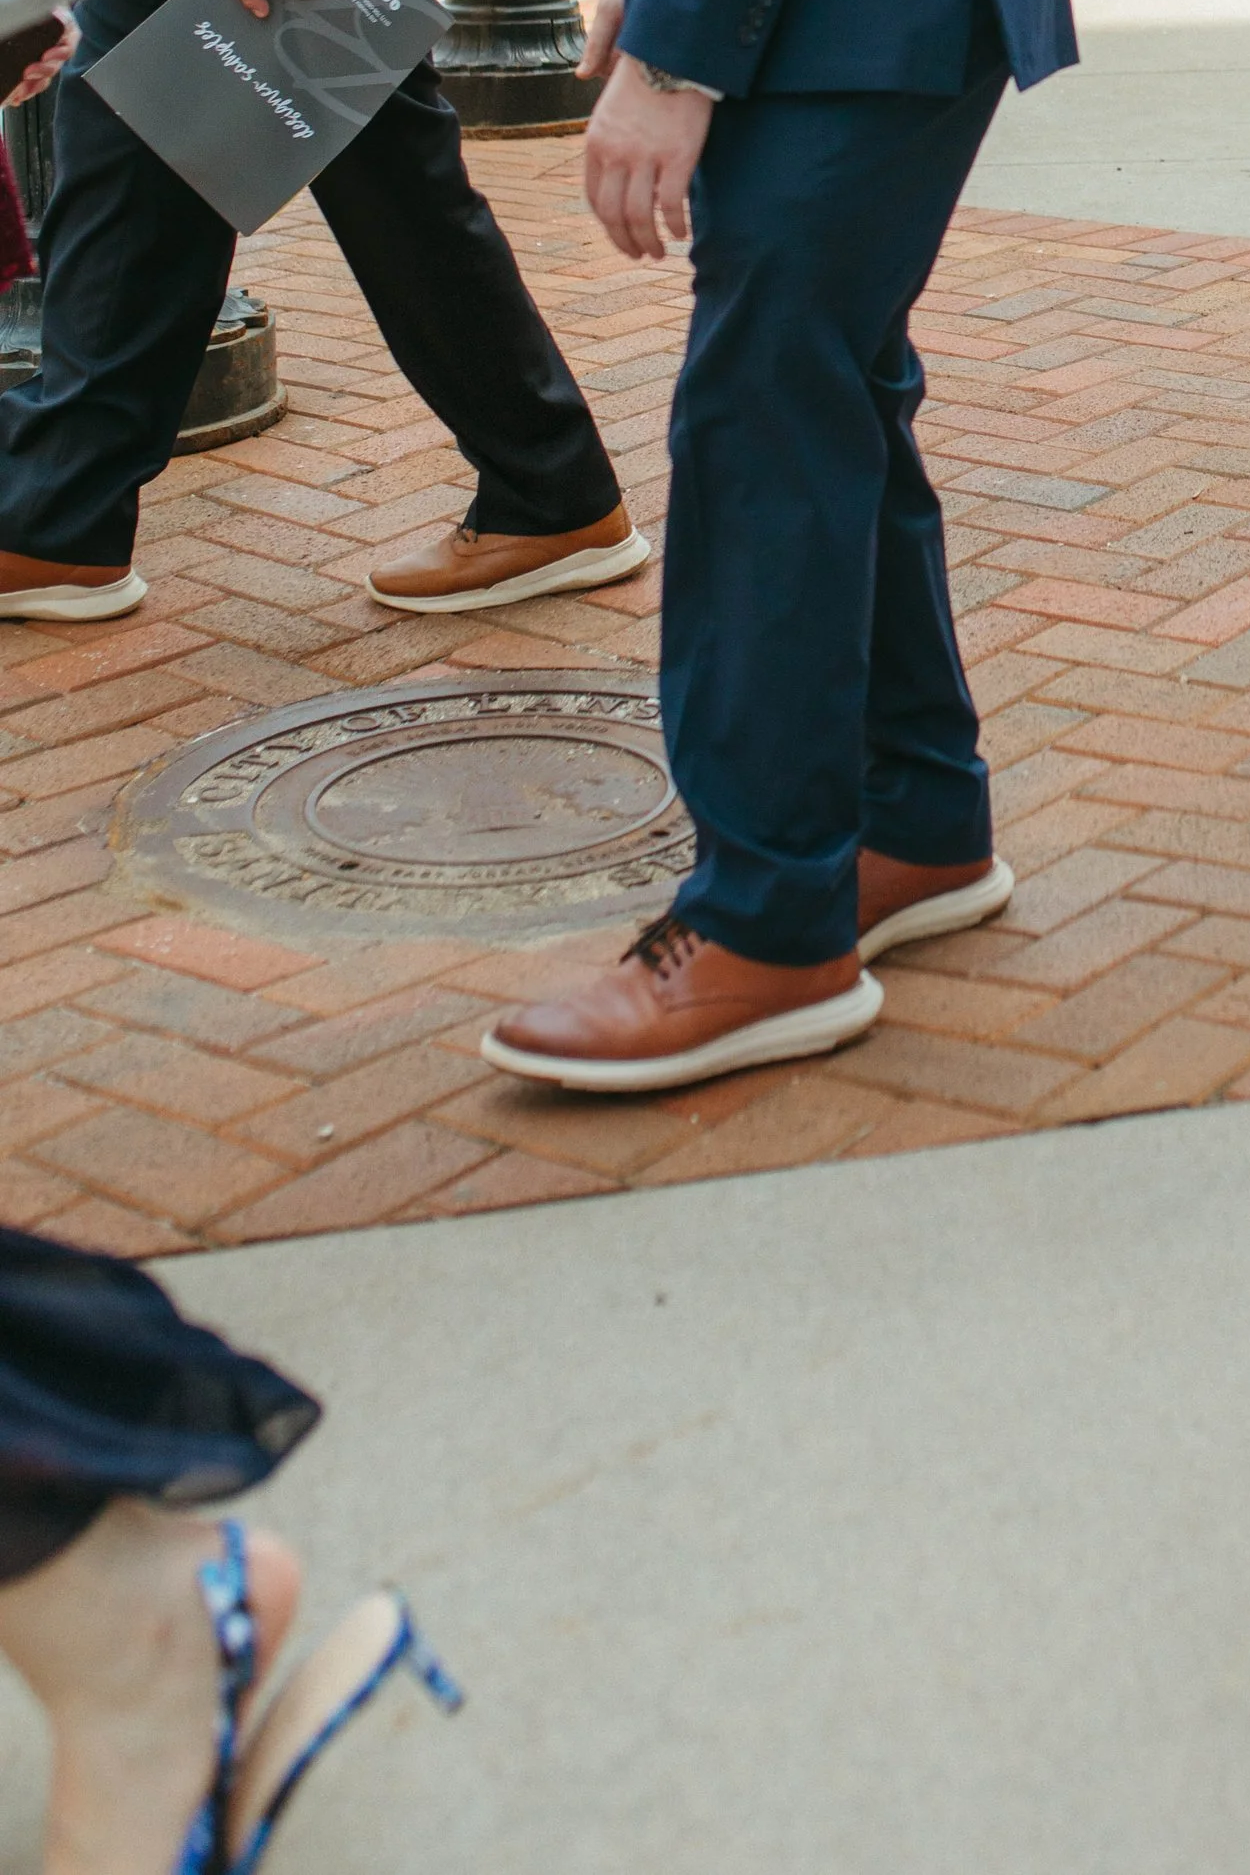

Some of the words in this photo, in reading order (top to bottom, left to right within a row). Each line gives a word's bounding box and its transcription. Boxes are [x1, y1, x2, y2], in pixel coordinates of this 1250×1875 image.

[193, 21, 257, 81] samples
[252, 81, 314, 138] designer
[199, 742, 314, 803] CITY
[340, 706, 428, 732] OF
[467, 693, 662, 721] LANS
